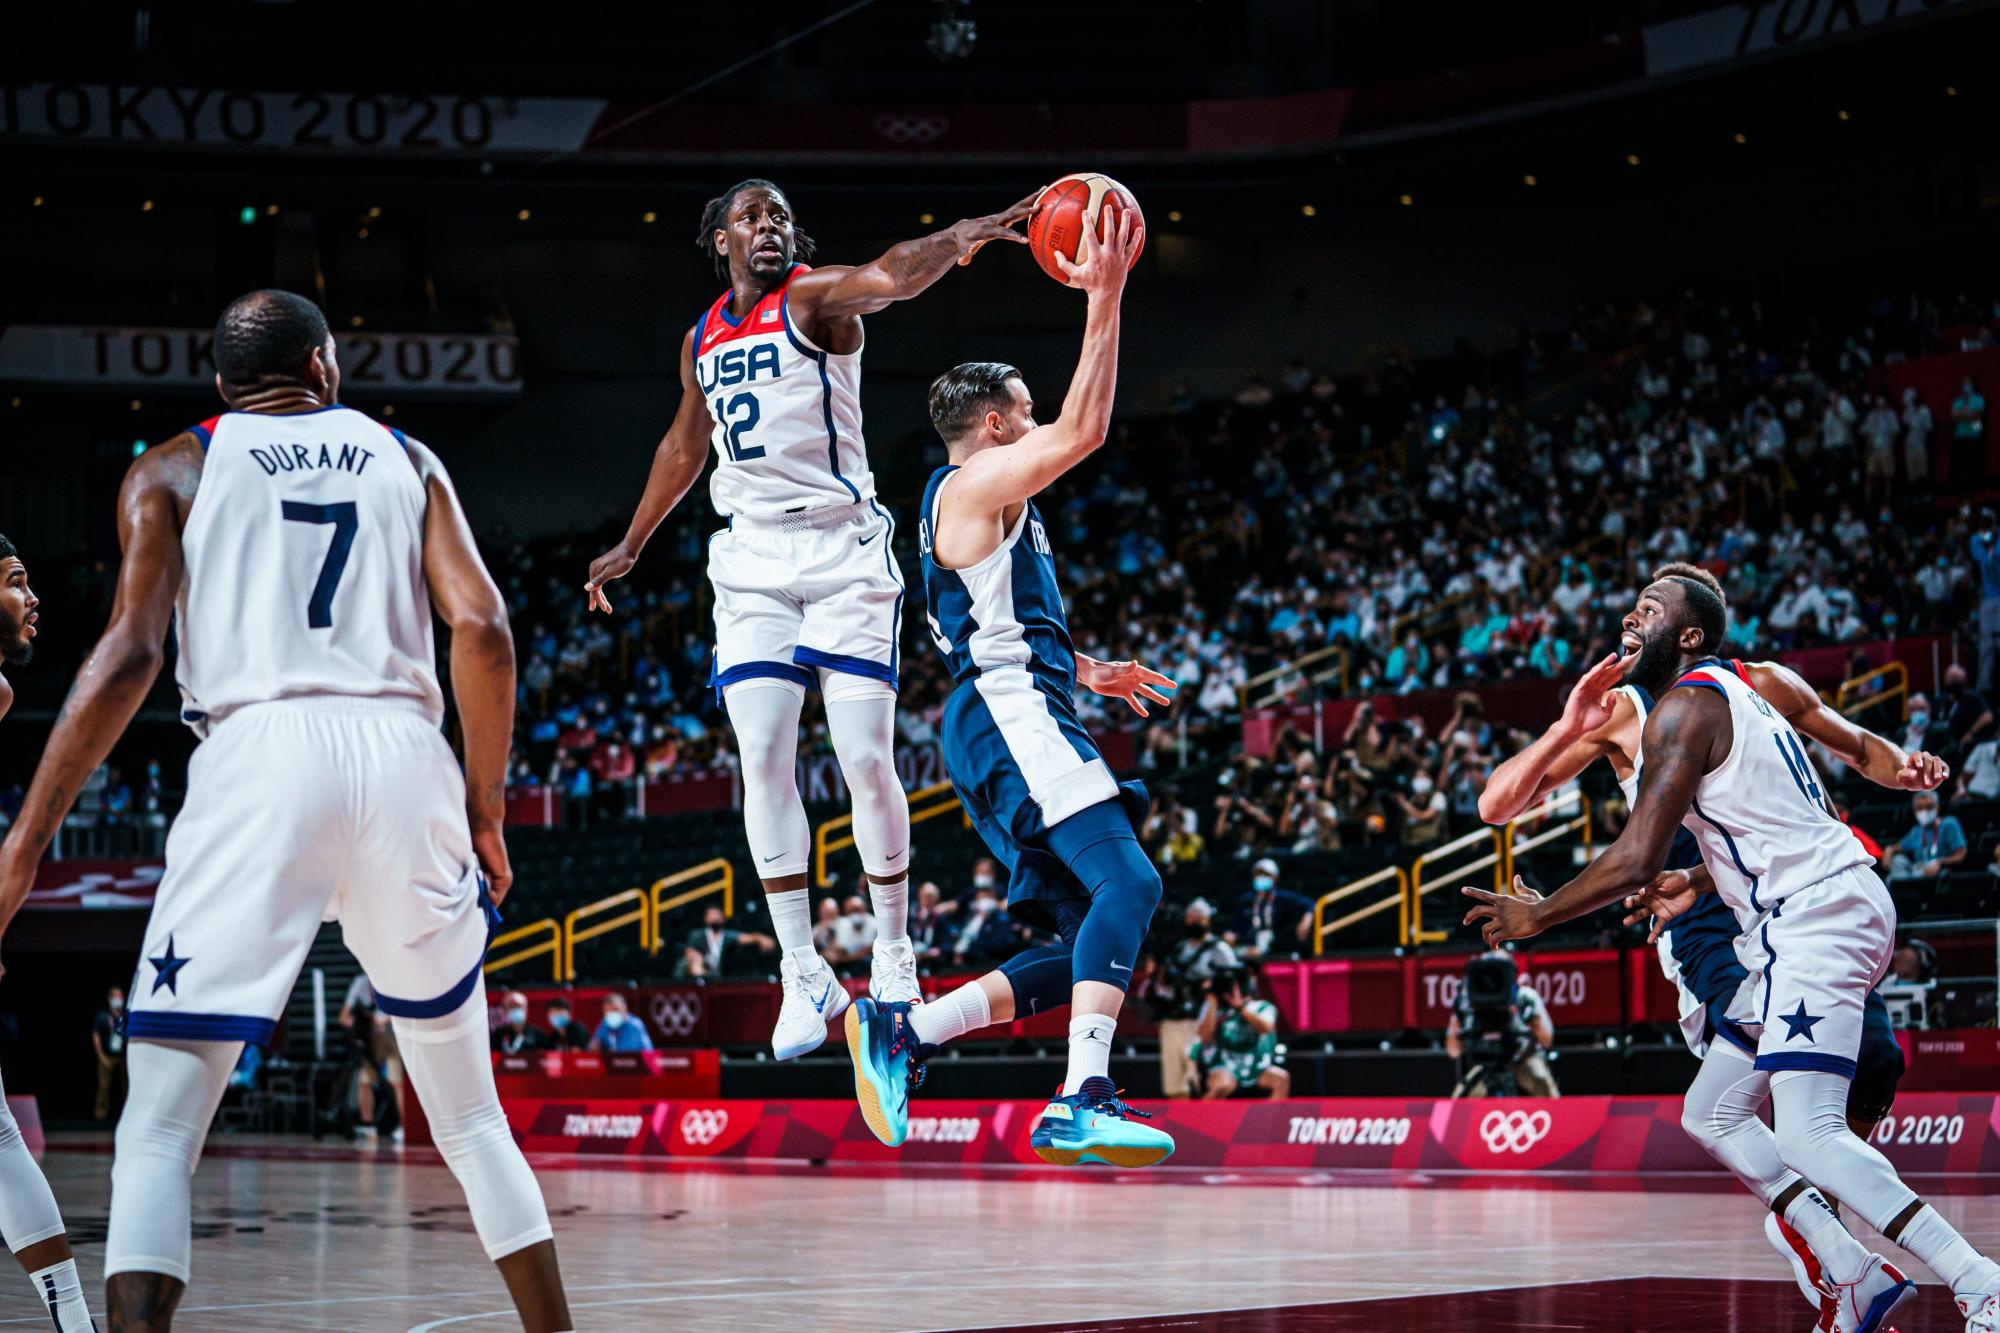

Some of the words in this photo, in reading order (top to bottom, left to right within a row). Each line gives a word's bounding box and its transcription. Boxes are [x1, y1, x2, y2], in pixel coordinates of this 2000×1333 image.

[0, 80, 264, 142] TOKYO
[293, 95, 492, 146] 2020
[84, 328, 218, 376] TOK
[349, 334, 523, 383] 2020
[698, 342, 782, 396] USA
[715, 391, 767, 462] 12
[248, 442, 376, 477] DURANT
[280, 499, 360, 631] 7
[1534, 970, 1587, 1006] 020
[934, 1116, 981, 1142] 2020
[1287, 1116, 1358, 1145] TOKYO
[1353, 1116, 1412, 1146] 2020
[1896, 1114, 1965, 1146] 2020
